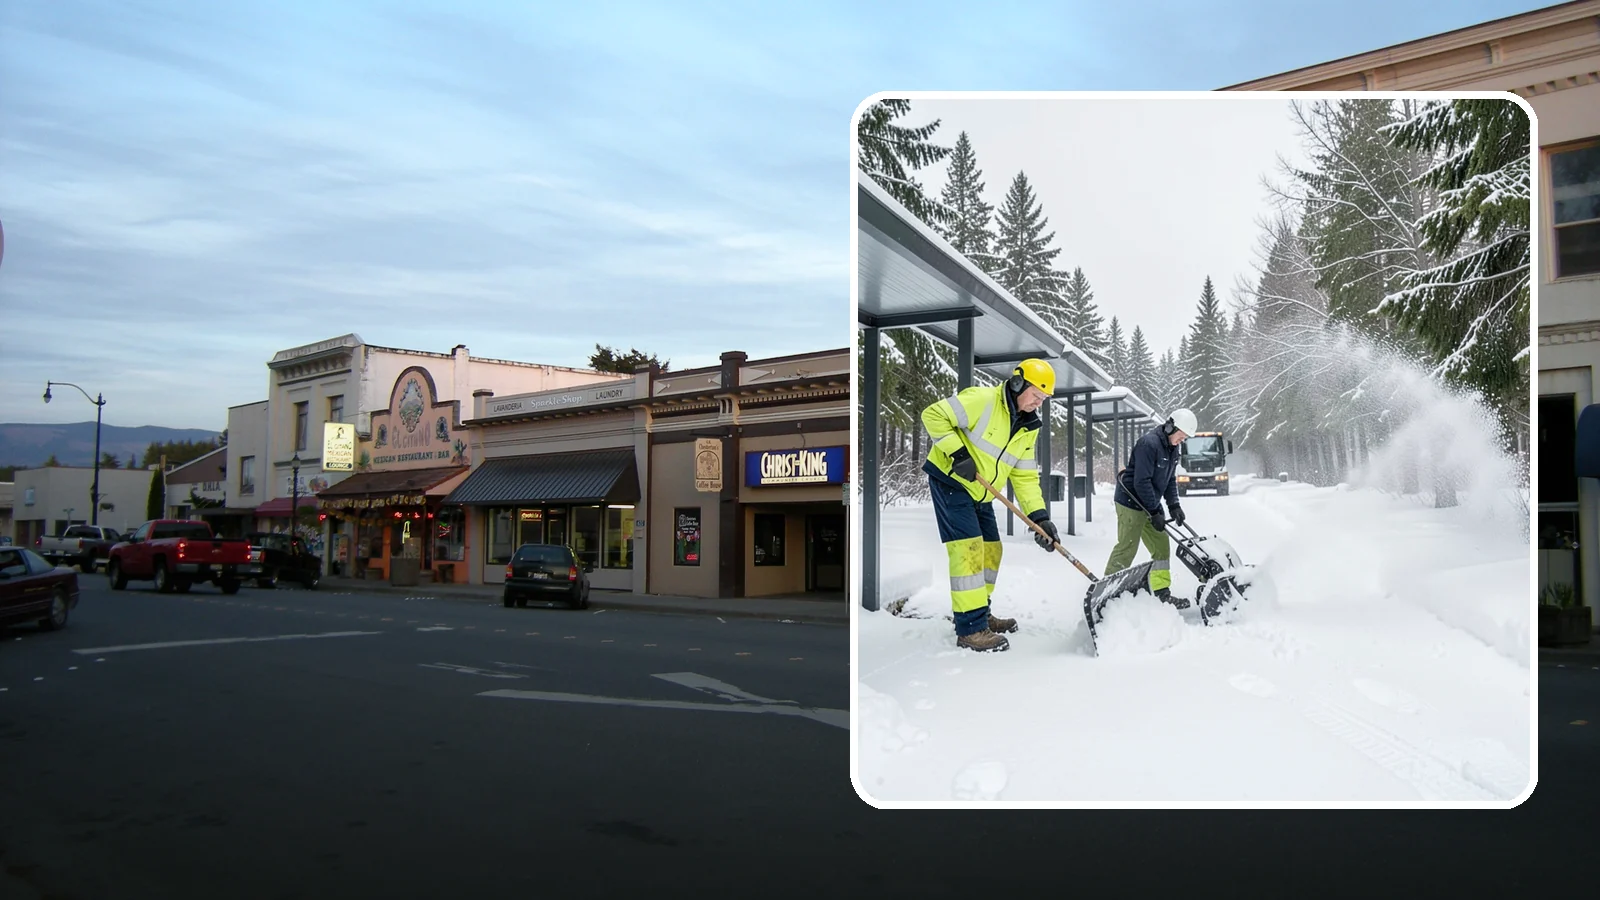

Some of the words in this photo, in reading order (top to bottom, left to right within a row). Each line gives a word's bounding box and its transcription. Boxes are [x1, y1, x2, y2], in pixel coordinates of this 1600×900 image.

[562, 394, 582, 405] Shop
[595, 388, 624, 400] LAUNDRY
[398, 451, 433, 462] RESTAURANT
[438, 450, 450, 459] BAR
